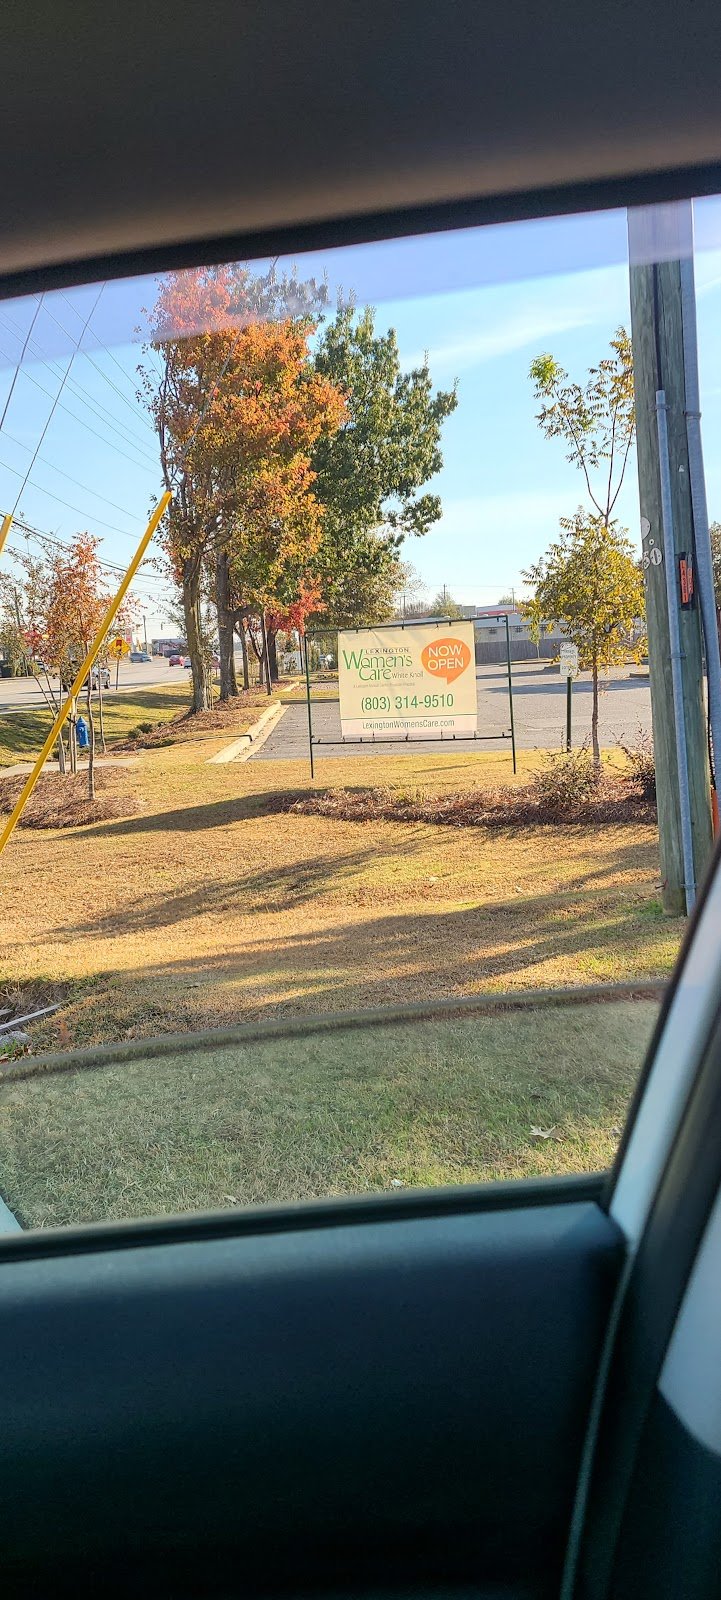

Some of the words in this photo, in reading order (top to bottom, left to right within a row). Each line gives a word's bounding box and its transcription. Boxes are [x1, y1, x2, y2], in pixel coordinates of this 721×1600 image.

[428, 644, 462, 657] NOW
[342, 649, 413, 670] Women's
[427, 658, 464, 671] OPEN
[359, 667, 392, 681] Care
[361, 696, 391, 712] (803)
[395, 693, 454, 710] 314-9510
[362, 719, 455, 731] LexingtonWomensCare.com
